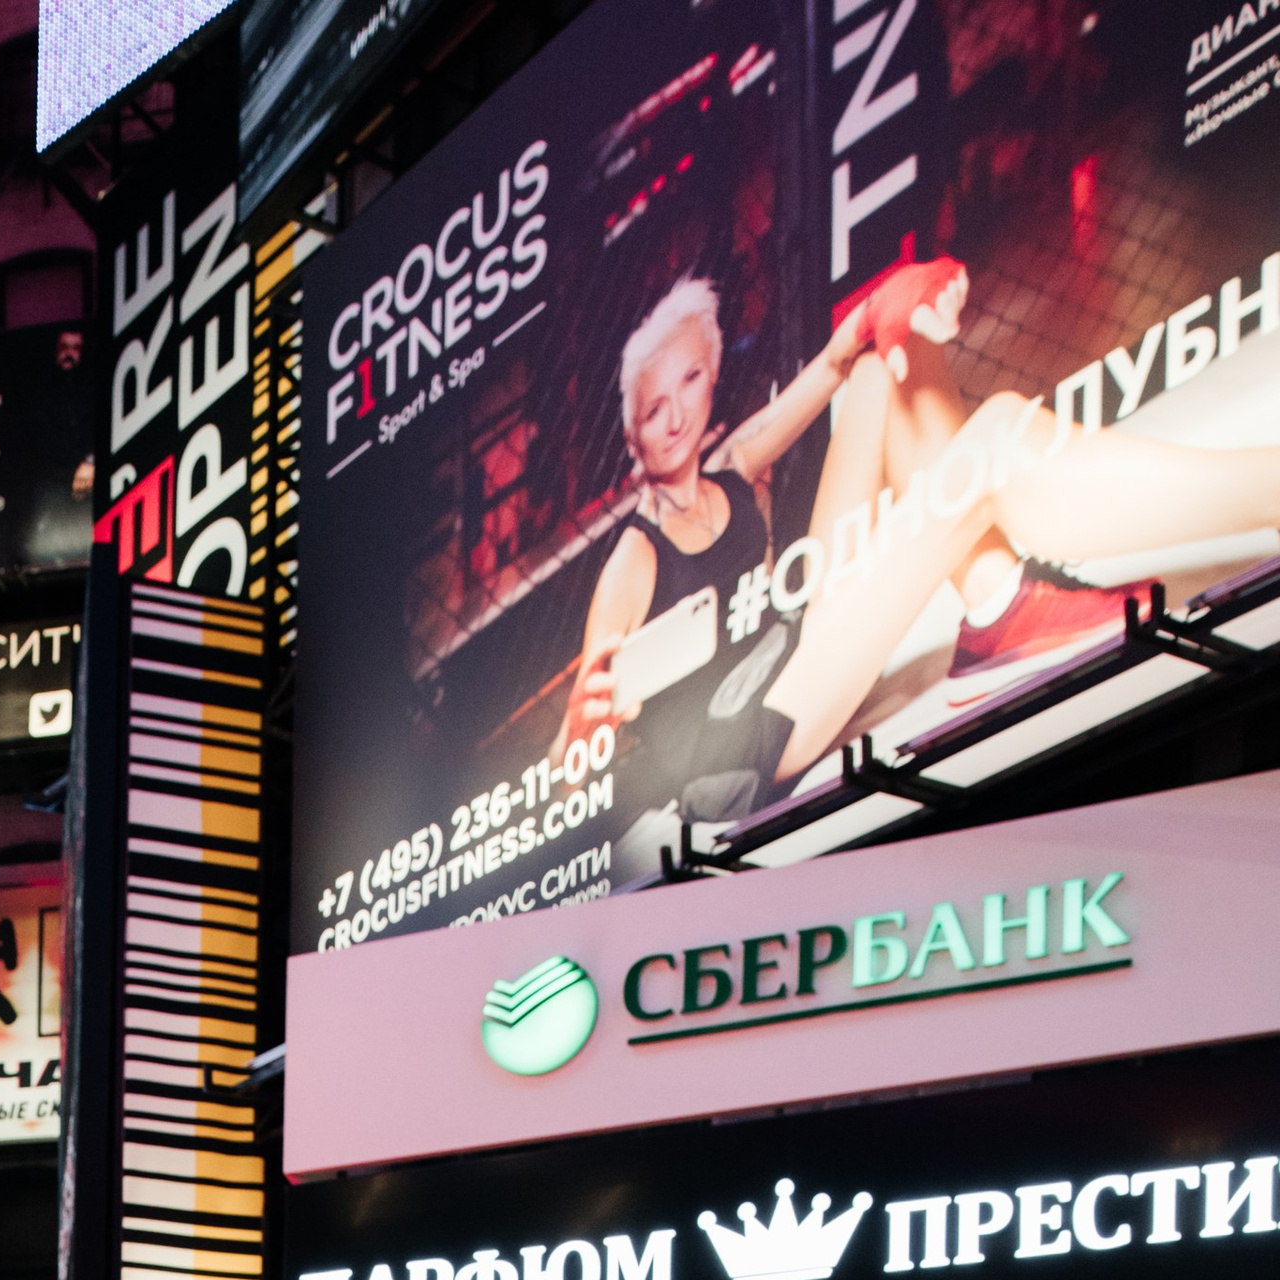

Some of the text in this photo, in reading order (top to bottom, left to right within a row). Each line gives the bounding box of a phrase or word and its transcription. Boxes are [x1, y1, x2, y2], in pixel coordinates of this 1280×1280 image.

[328, 139, 549, 371] CROCUS
[378, 347, 486, 444] Sport & Spa
[317, 723, 616, 918] +7 (495) 236-11-00
[317, 772, 614, 954] CROCUSFITNESS.COM
[540, 840, 612, 900] СИТИ
[622, 872, 1129, 1023] СБЕРБАНК
[883, 1154, 1280, 1274] ПРЕСТИ
